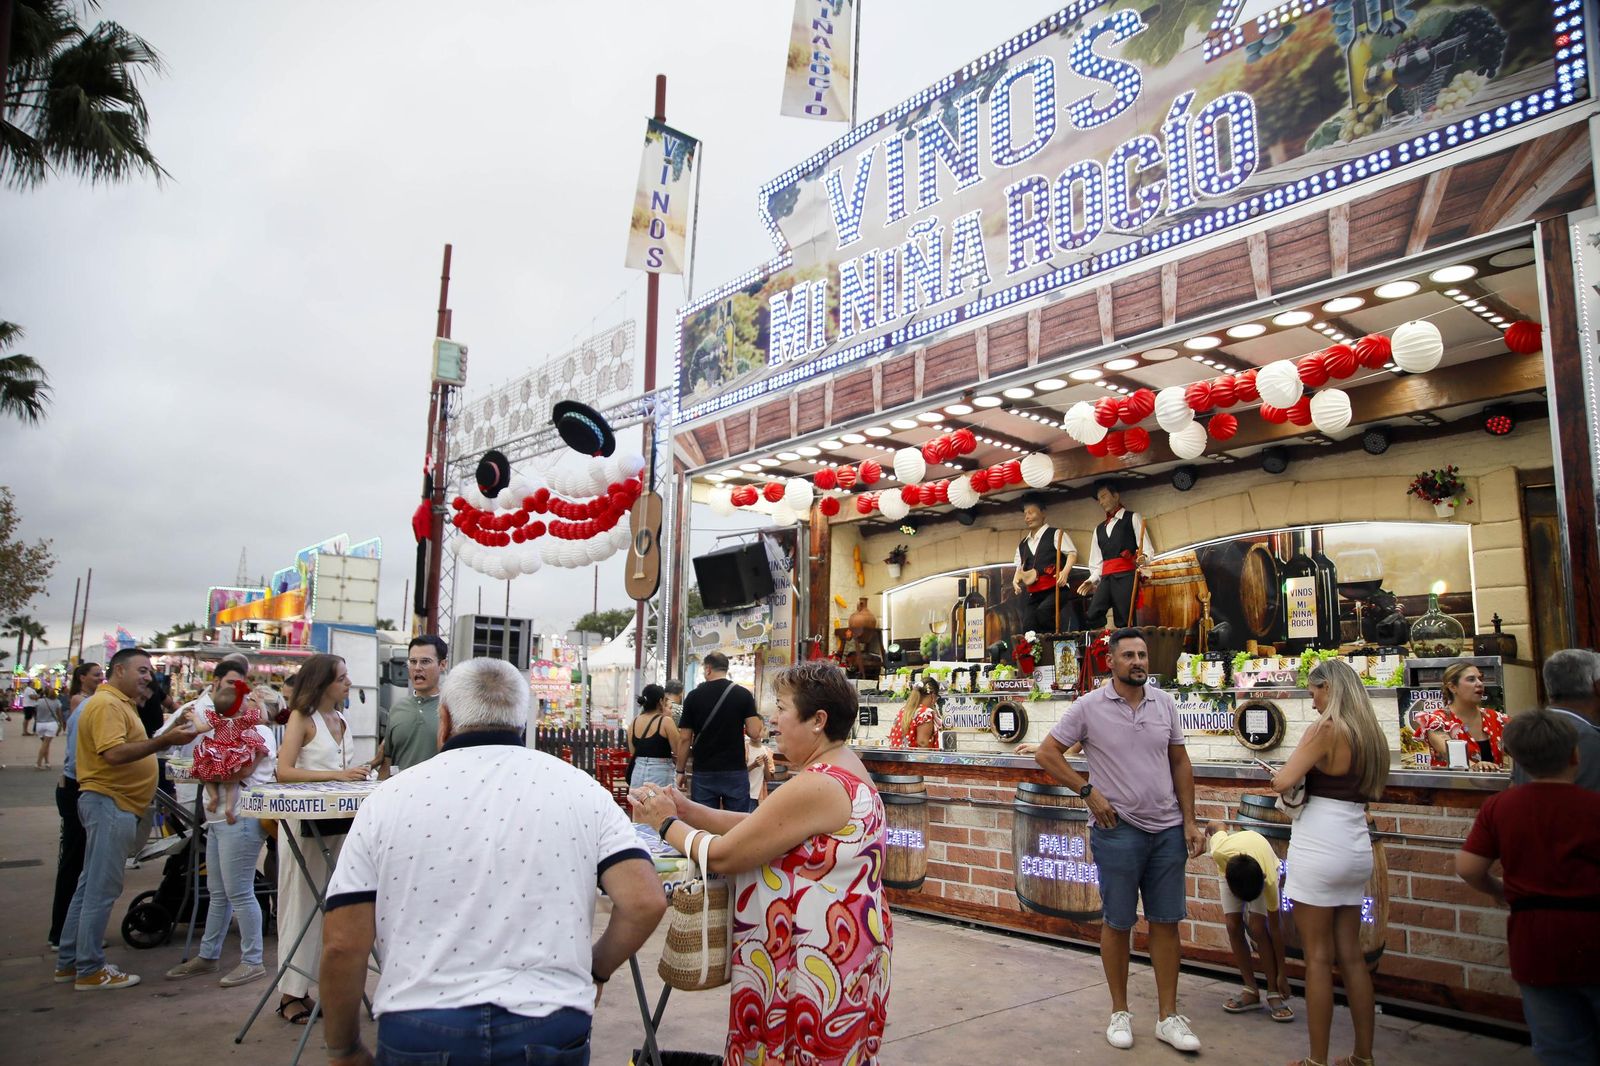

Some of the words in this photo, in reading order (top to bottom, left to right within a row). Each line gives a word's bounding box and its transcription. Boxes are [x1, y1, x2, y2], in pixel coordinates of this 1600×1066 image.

[819, 8, 1149, 251] VINOS
[646, 133, 679, 268] VINOS
[767, 278, 829, 369] MI
[838, 208, 991, 345] NIÑA
[1004, 89, 1261, 277] ROCÍO
[1290, 588, 1313, 597] VINOS
[1297, 601, 1307, 609] MI
[994, 680, 1033, 689] MOSCATEL
[269, 798, 327, 814] MOSCATEL
[1039, 833, 1084, 858] PALO
